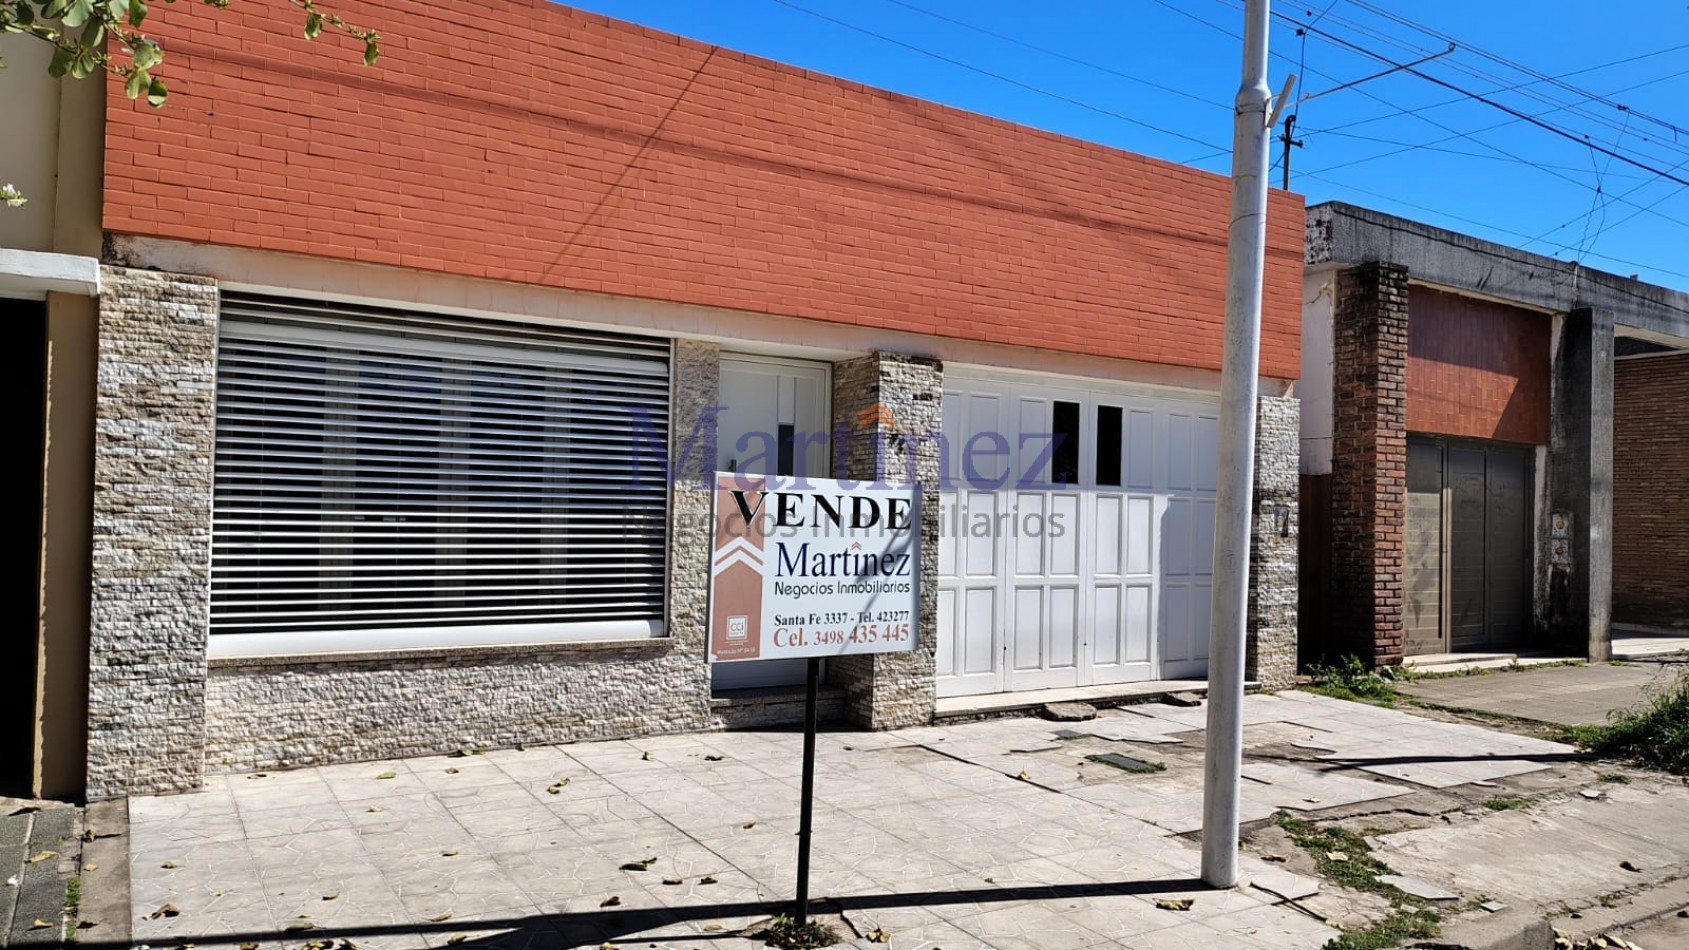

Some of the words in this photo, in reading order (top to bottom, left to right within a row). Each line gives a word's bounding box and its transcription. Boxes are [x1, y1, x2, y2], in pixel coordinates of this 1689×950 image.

[731, 490, 912, 530] VENDE
[774, 581, 834, 600] Negocios
[838, 580, 910, 594] Inmobiliarios
[774, 613, 806, 627] Santa
[809, 613, 822, 625] Fe
[823, 612, 848, 625] 3337
[858, 611, 875, 624] Tel.
[876, 610, 909, 623] 423277
[773, 627, 808, 648] Cel.
[813, 631, 844, 646] 3498
[849, 624, 878, 644] 435
[882, 623, 909, 642] 445
